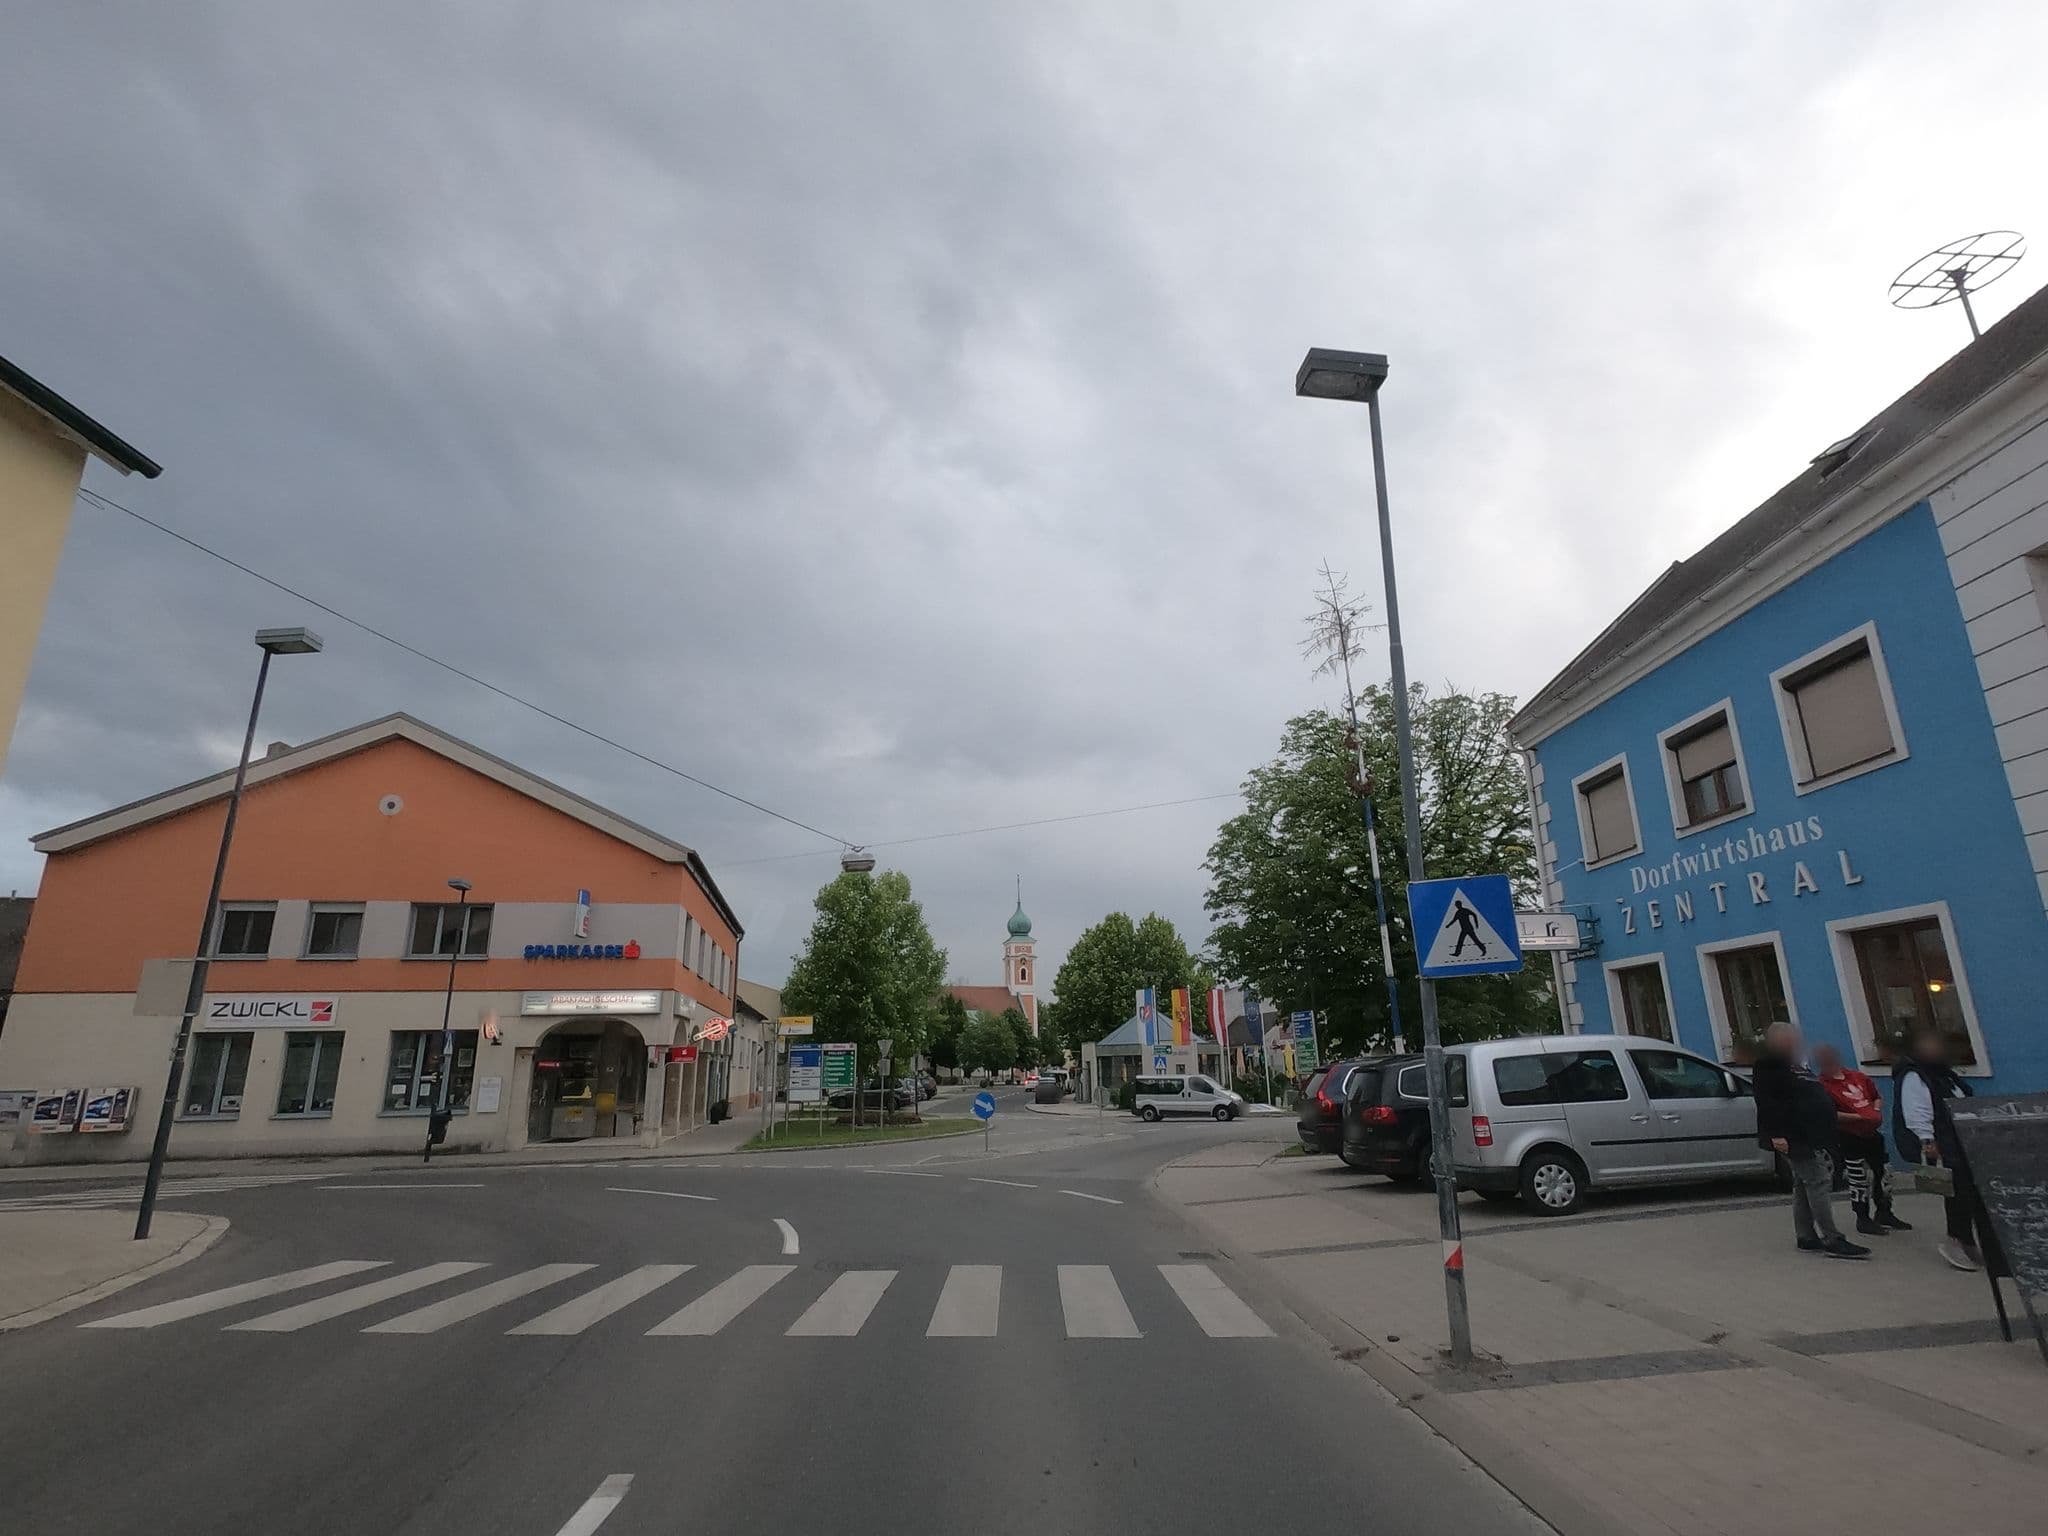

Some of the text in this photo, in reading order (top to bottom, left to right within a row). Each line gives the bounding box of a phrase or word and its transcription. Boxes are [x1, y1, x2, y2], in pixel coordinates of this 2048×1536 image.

[1630, 815, 1824, 894] Dorfwirtshaus
[1621, 849, 1865, 935] ZENTRAL
[524, 944, 624, 959] SPARKASSE
[210, 1002, 308, 1017] ZWICKL
